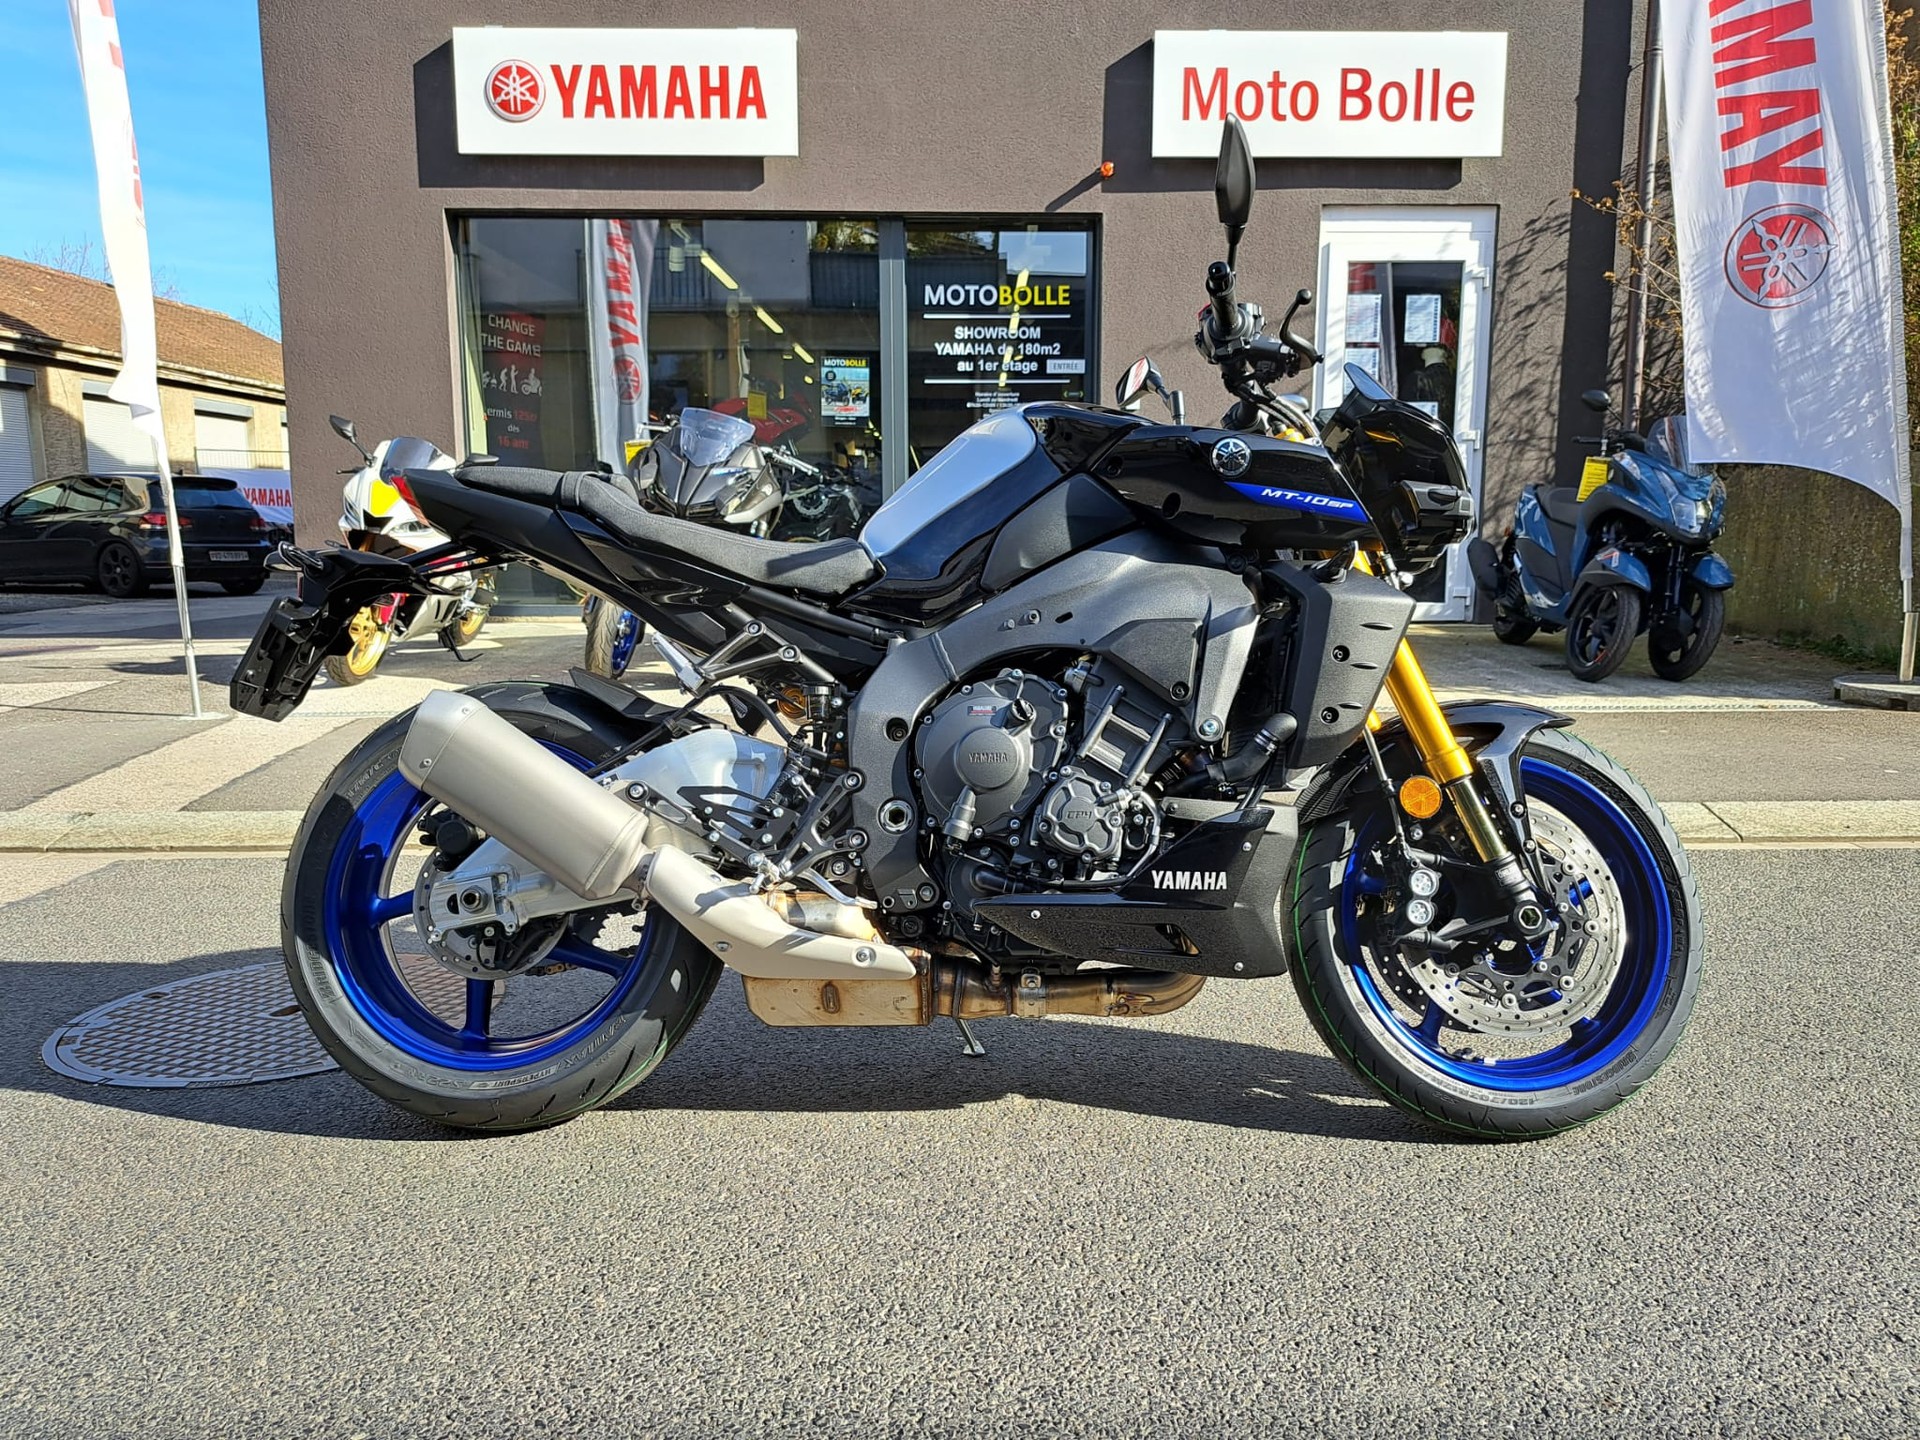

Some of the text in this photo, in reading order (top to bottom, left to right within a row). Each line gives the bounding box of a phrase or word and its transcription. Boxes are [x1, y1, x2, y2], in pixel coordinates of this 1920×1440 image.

[550, 64, 767, 119] YAMAHA
[1182, 67, 1475, 122] Moto Bolle
[924, 284, 1071, 306] MOTOBOLLE
[488, 314, 536, 337] CHANGE
[954, 326, 1041, 339] SHOWROOM
[480, 333, 541, 358] THE GAME
[934, 342, 995, 355] YAMAHA
[1018, 342, 1061, 355] 180m2
[957, 361, 974, 371] au
[978, 359, 999, 371] 1er
[487, 407, 512, 419] ermis
[243, 487, 292, 507] YAMAHA
[968, 752, 1008, 763] YAMAHA
[1152, 870, 1228, 890] YAMAHA
